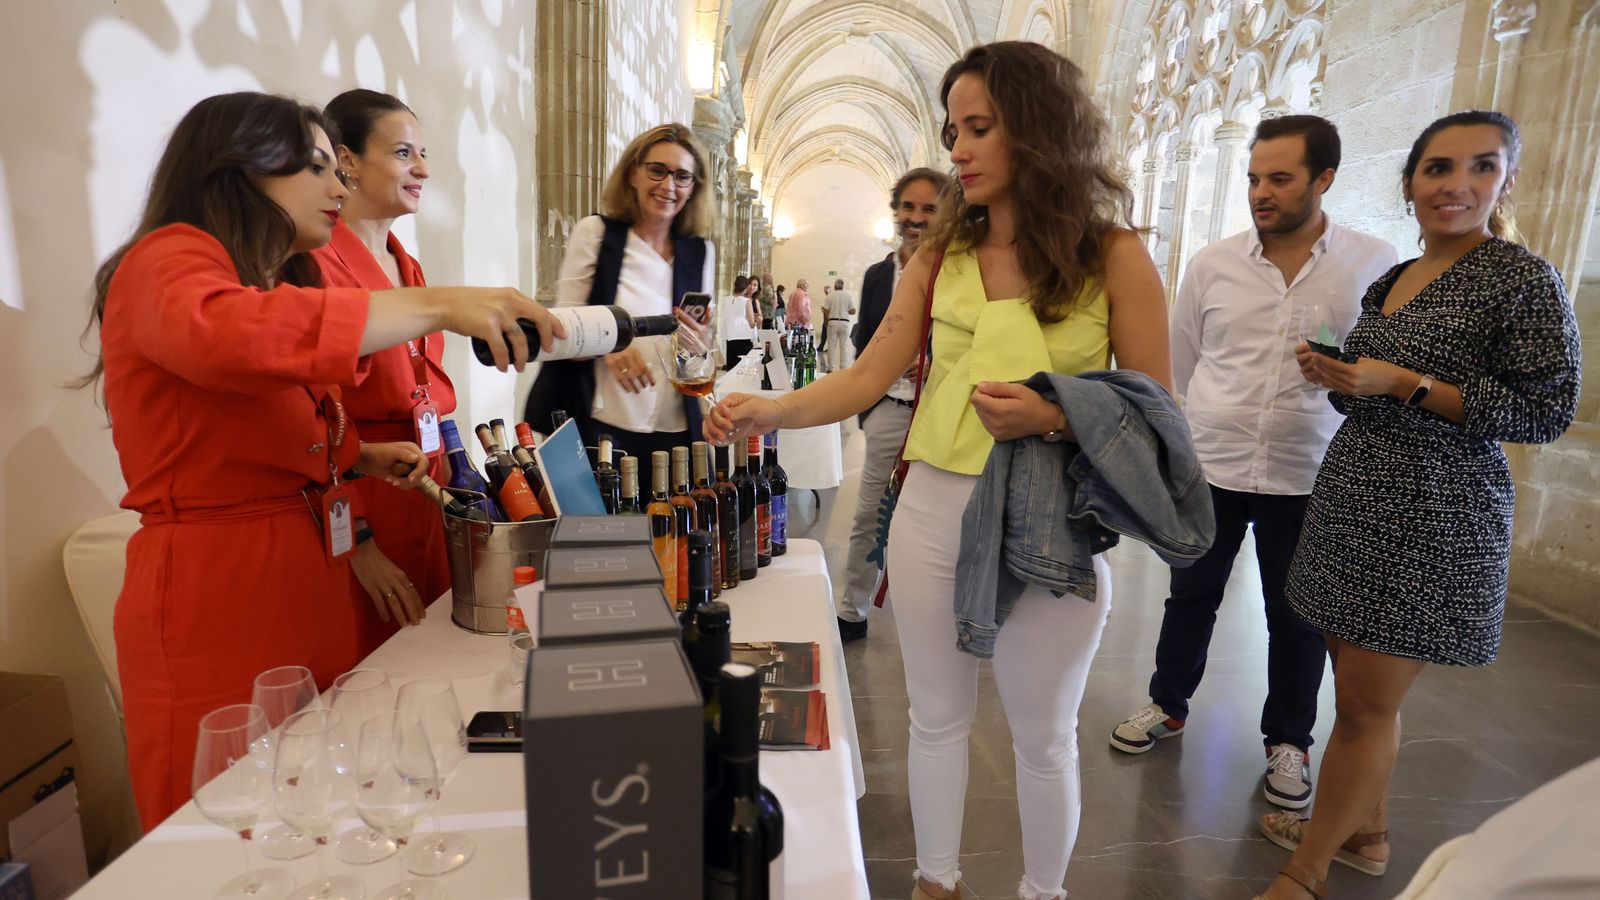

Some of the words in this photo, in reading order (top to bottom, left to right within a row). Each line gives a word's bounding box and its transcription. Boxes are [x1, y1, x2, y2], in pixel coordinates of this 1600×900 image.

[572, 599, 636, 621] H
[568, 659, 648, 692] H
[590, 763, 650, 900] EYS
